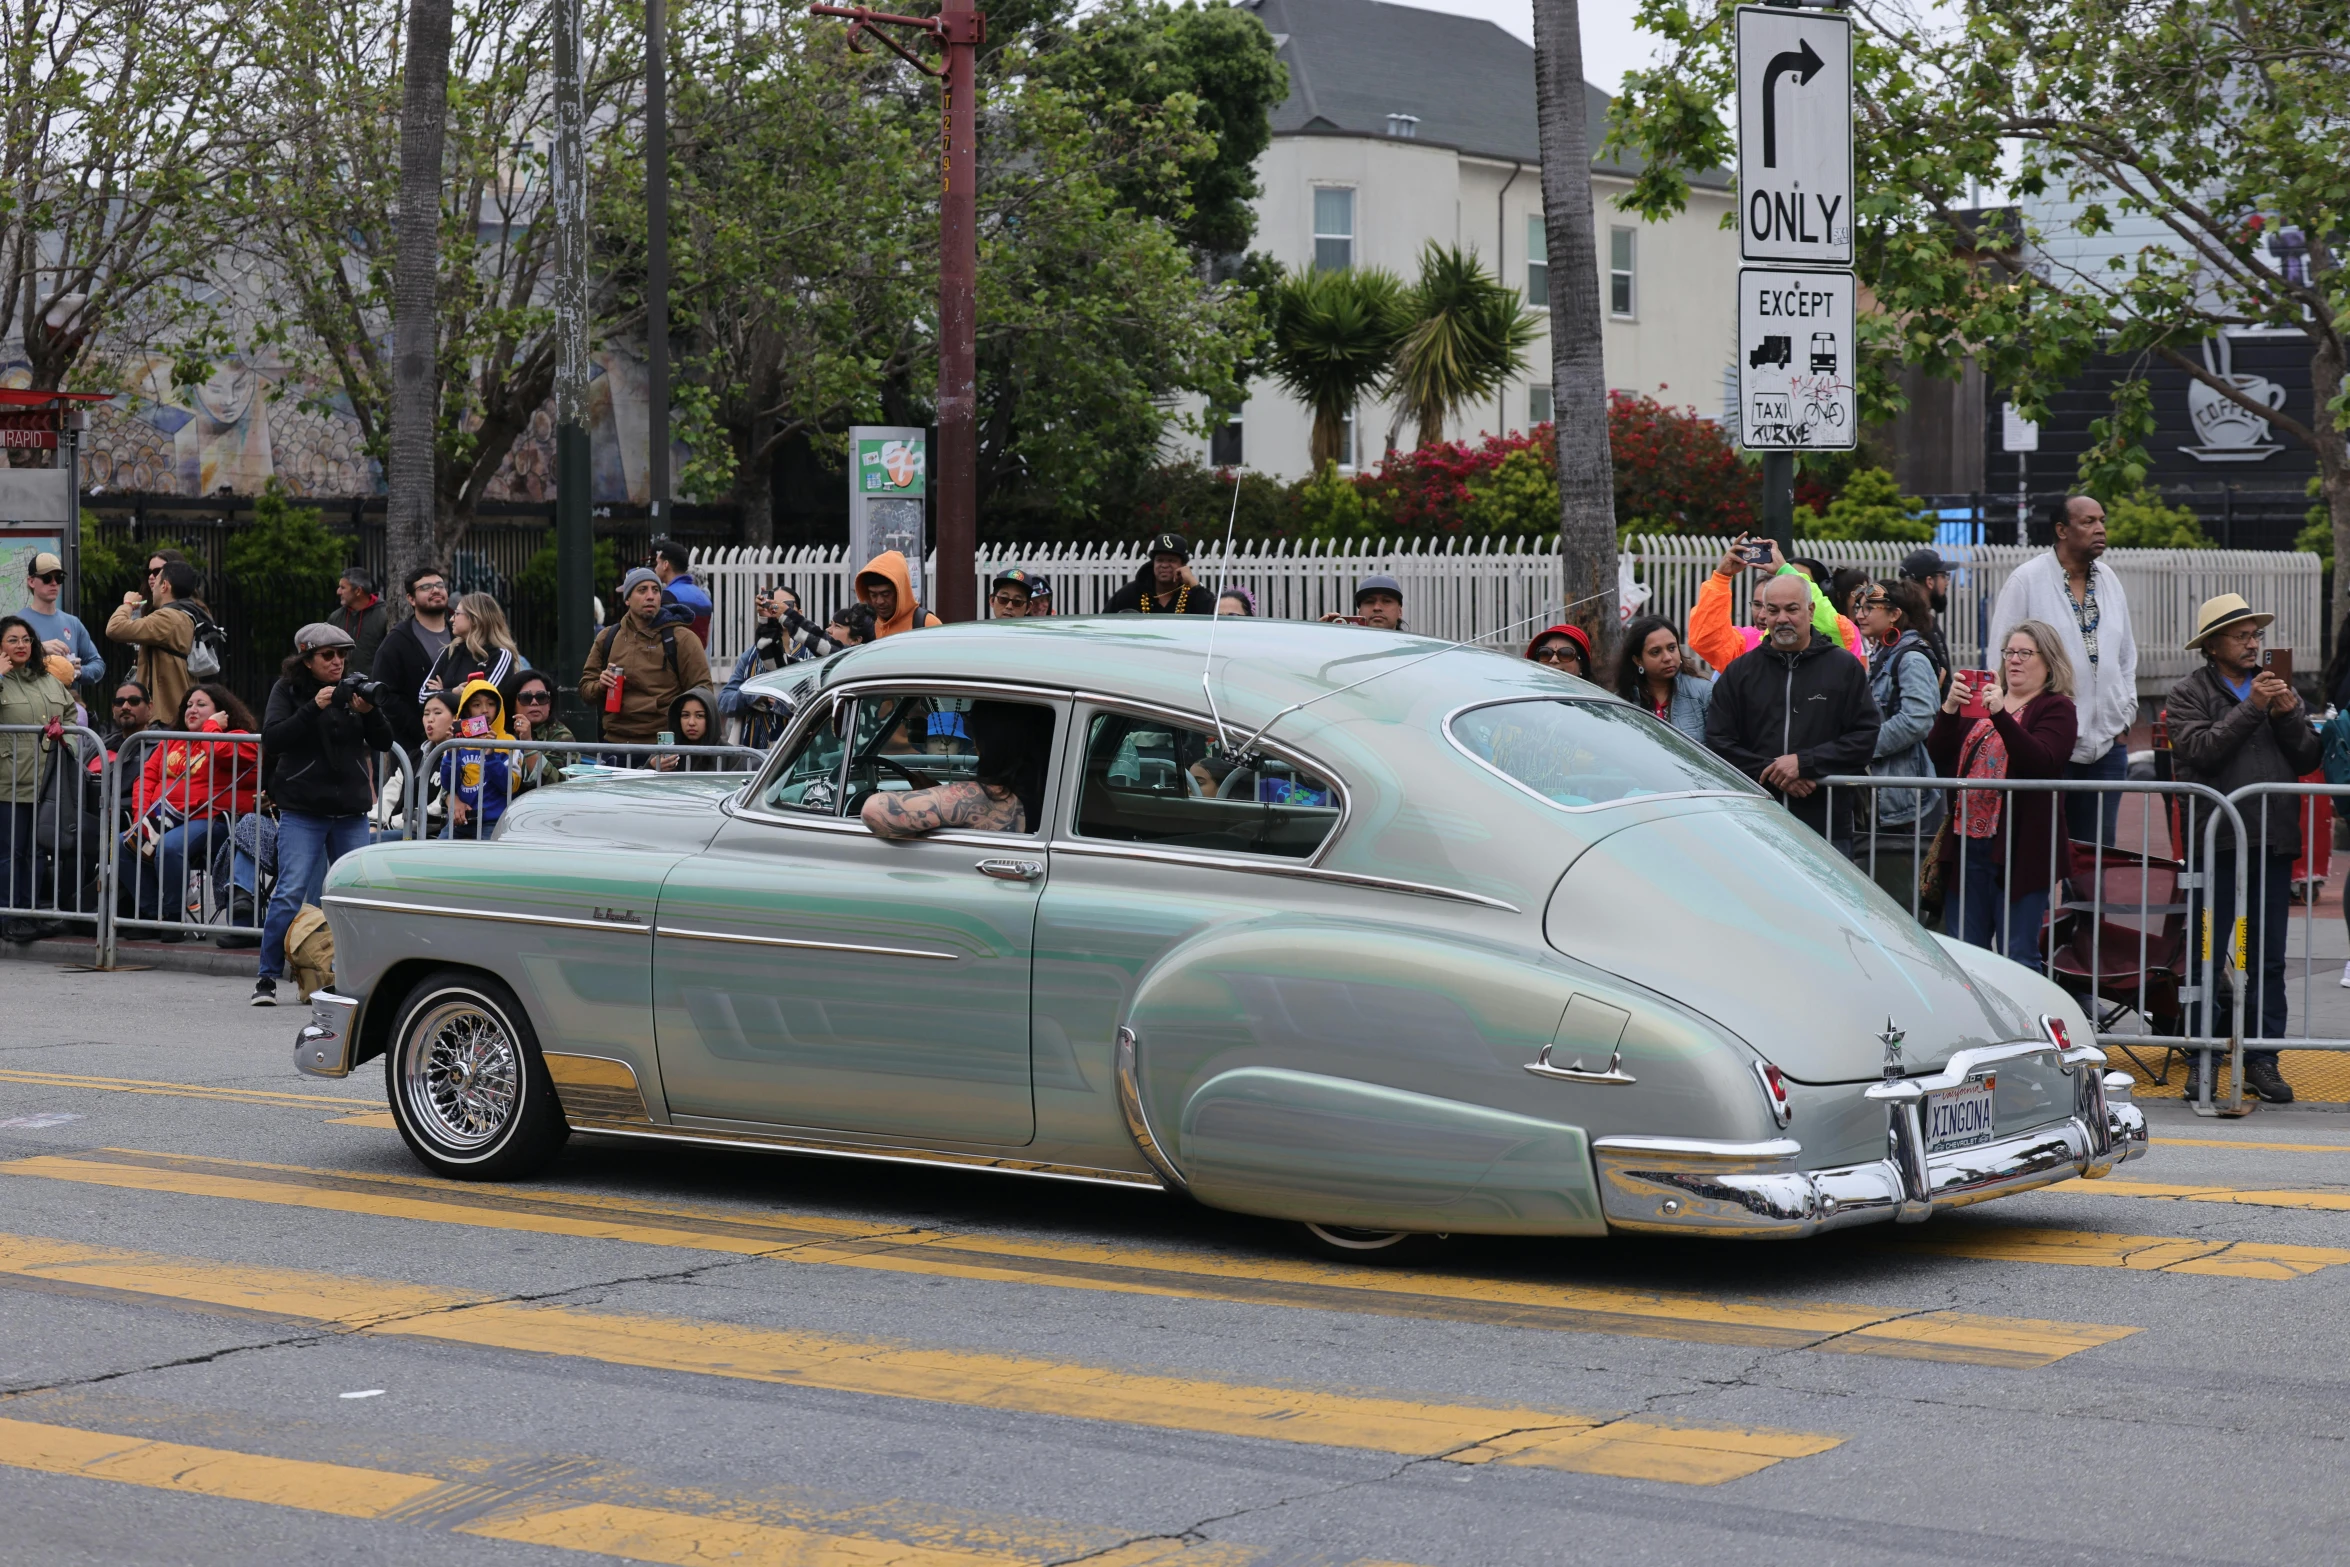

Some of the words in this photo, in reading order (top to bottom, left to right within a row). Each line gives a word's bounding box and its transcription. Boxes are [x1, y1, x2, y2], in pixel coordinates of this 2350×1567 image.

[1750, 189, 1842, 244] ONLY
[1759, 290, 1834, 318] EXCEPT
[1755, 402, 1788, 419] TAXI
[6, 431, 42, 448] RAPID
[1932, 1098, 1990, 1138] XINGONA
[1945, 1138, 1978, 1149] CHEVROLET
